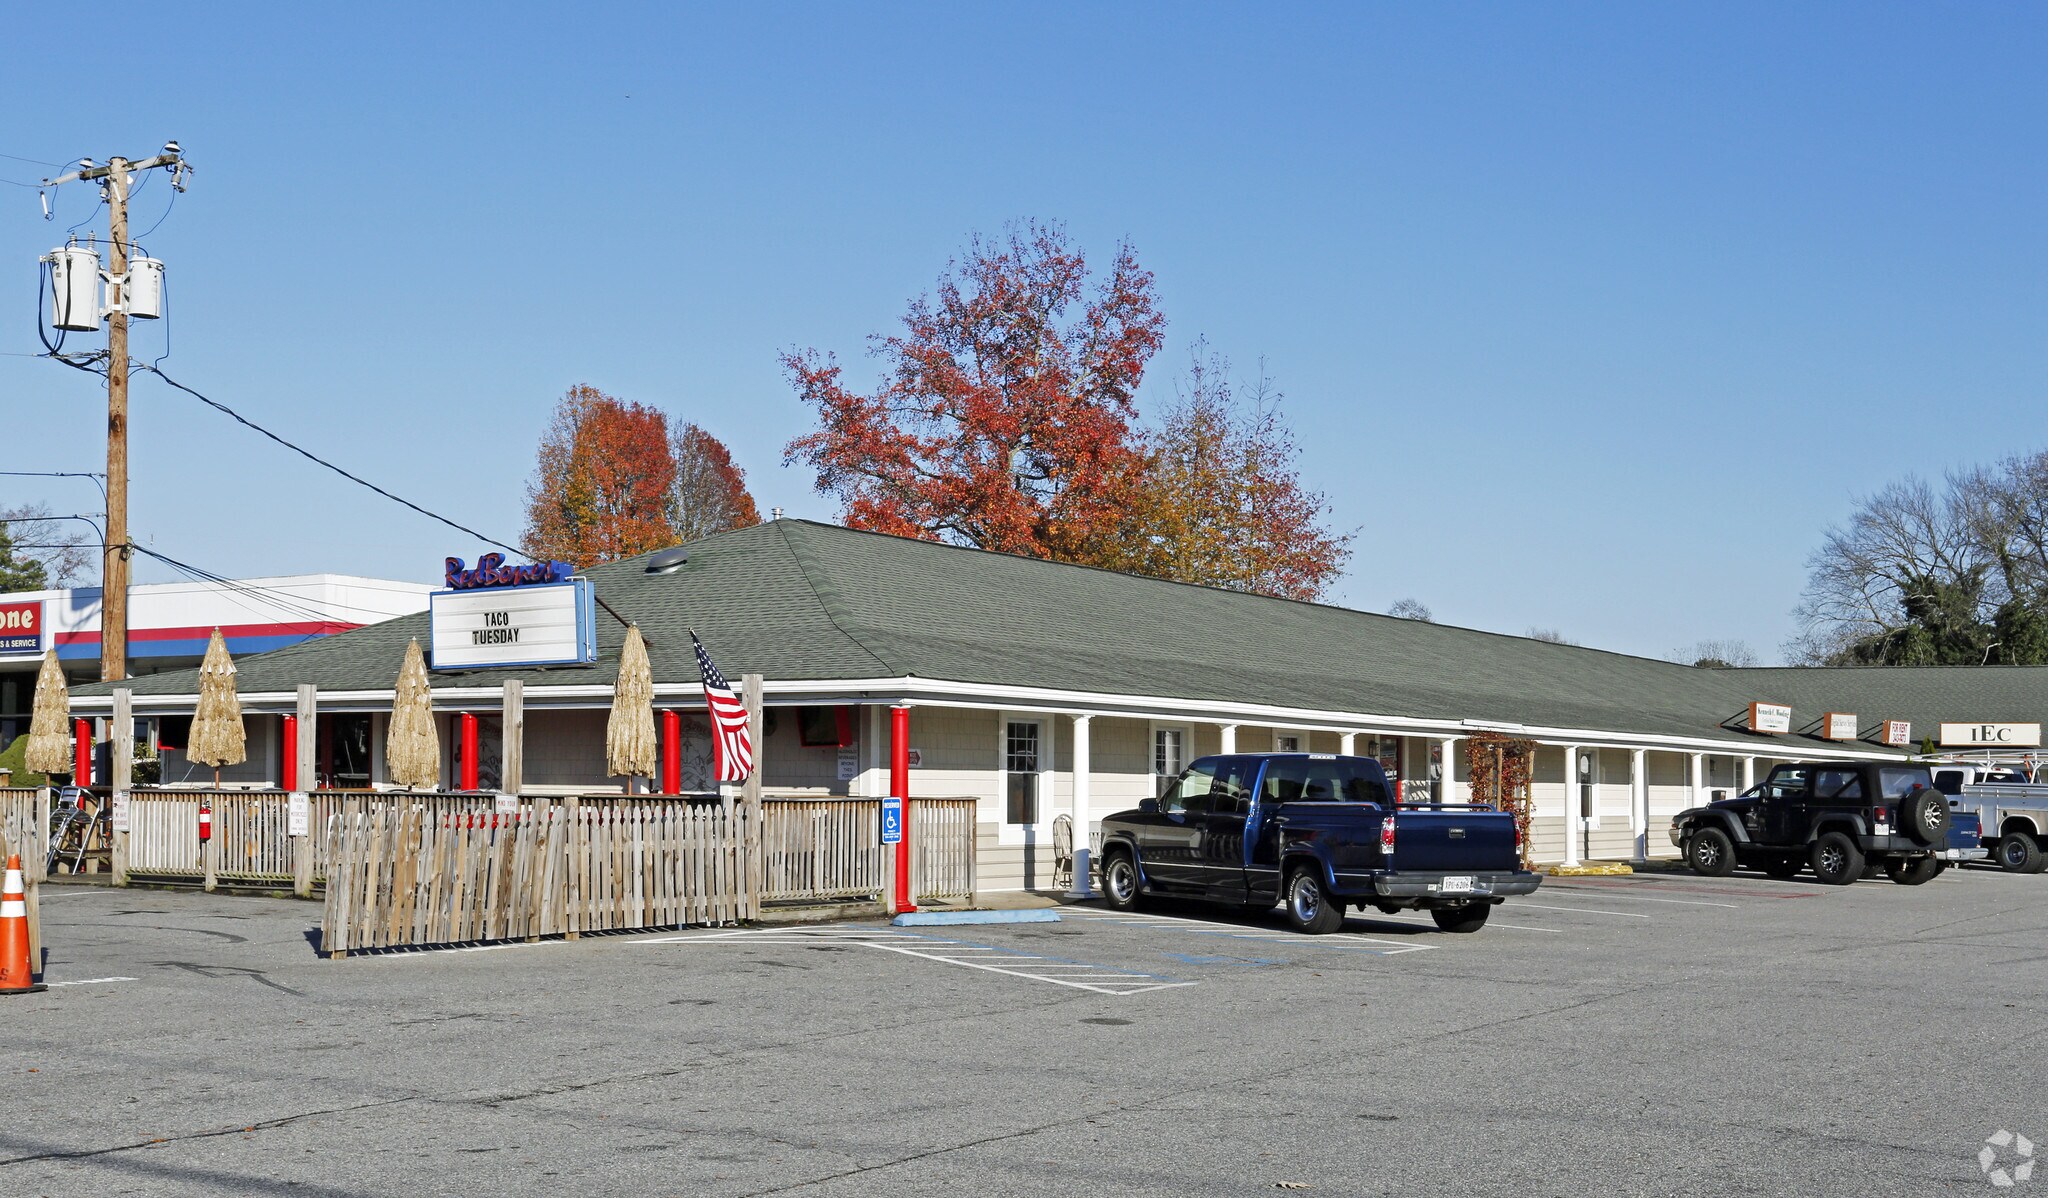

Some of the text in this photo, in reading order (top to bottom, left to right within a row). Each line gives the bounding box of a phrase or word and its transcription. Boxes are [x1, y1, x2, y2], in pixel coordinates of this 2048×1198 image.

[484, 612, 509, 627] TACO
[11, 639, 36, 648] SERVICE
[472, 628, 519, 645] TUESDAY
[1899, 723, 1908, 733] RENT
[1971, 725, 2011, 741] IEC
